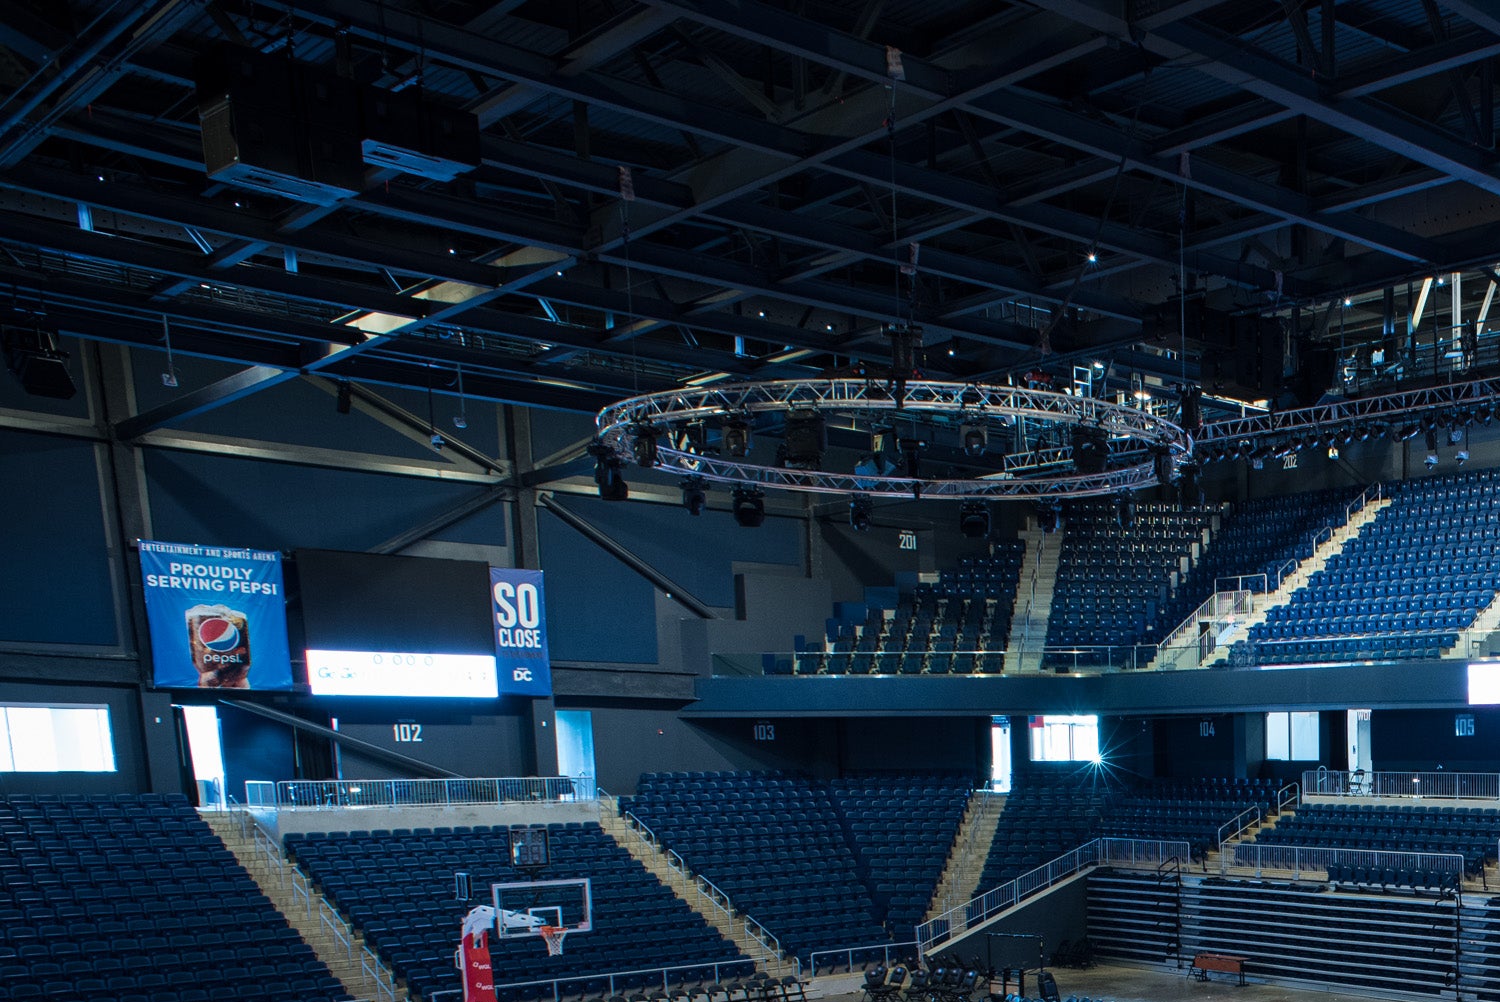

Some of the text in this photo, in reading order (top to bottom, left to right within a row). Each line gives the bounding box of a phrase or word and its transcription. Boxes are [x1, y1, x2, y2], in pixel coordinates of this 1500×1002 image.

[1282, 454, 1298, 469] 202
[899, 534, 917, 550] 201
[141, 543, 276, 562] ENTERTAINMENT AND SPORTS ARENA
[170, 562, 253, 580] PROUDLY
[146, 574, 278, 596] SERVING PEPSI
[493, 582, 539, 629] SO
[498, 628, 542, 649] CLOSE
[512, 670, 533, 682] DC
[393, 724, 423, 742] 102
[753, 725, 775, 740] 103
[1199, 722, 1216, 736] 104
[1455, 718, 1475, 736] 105
